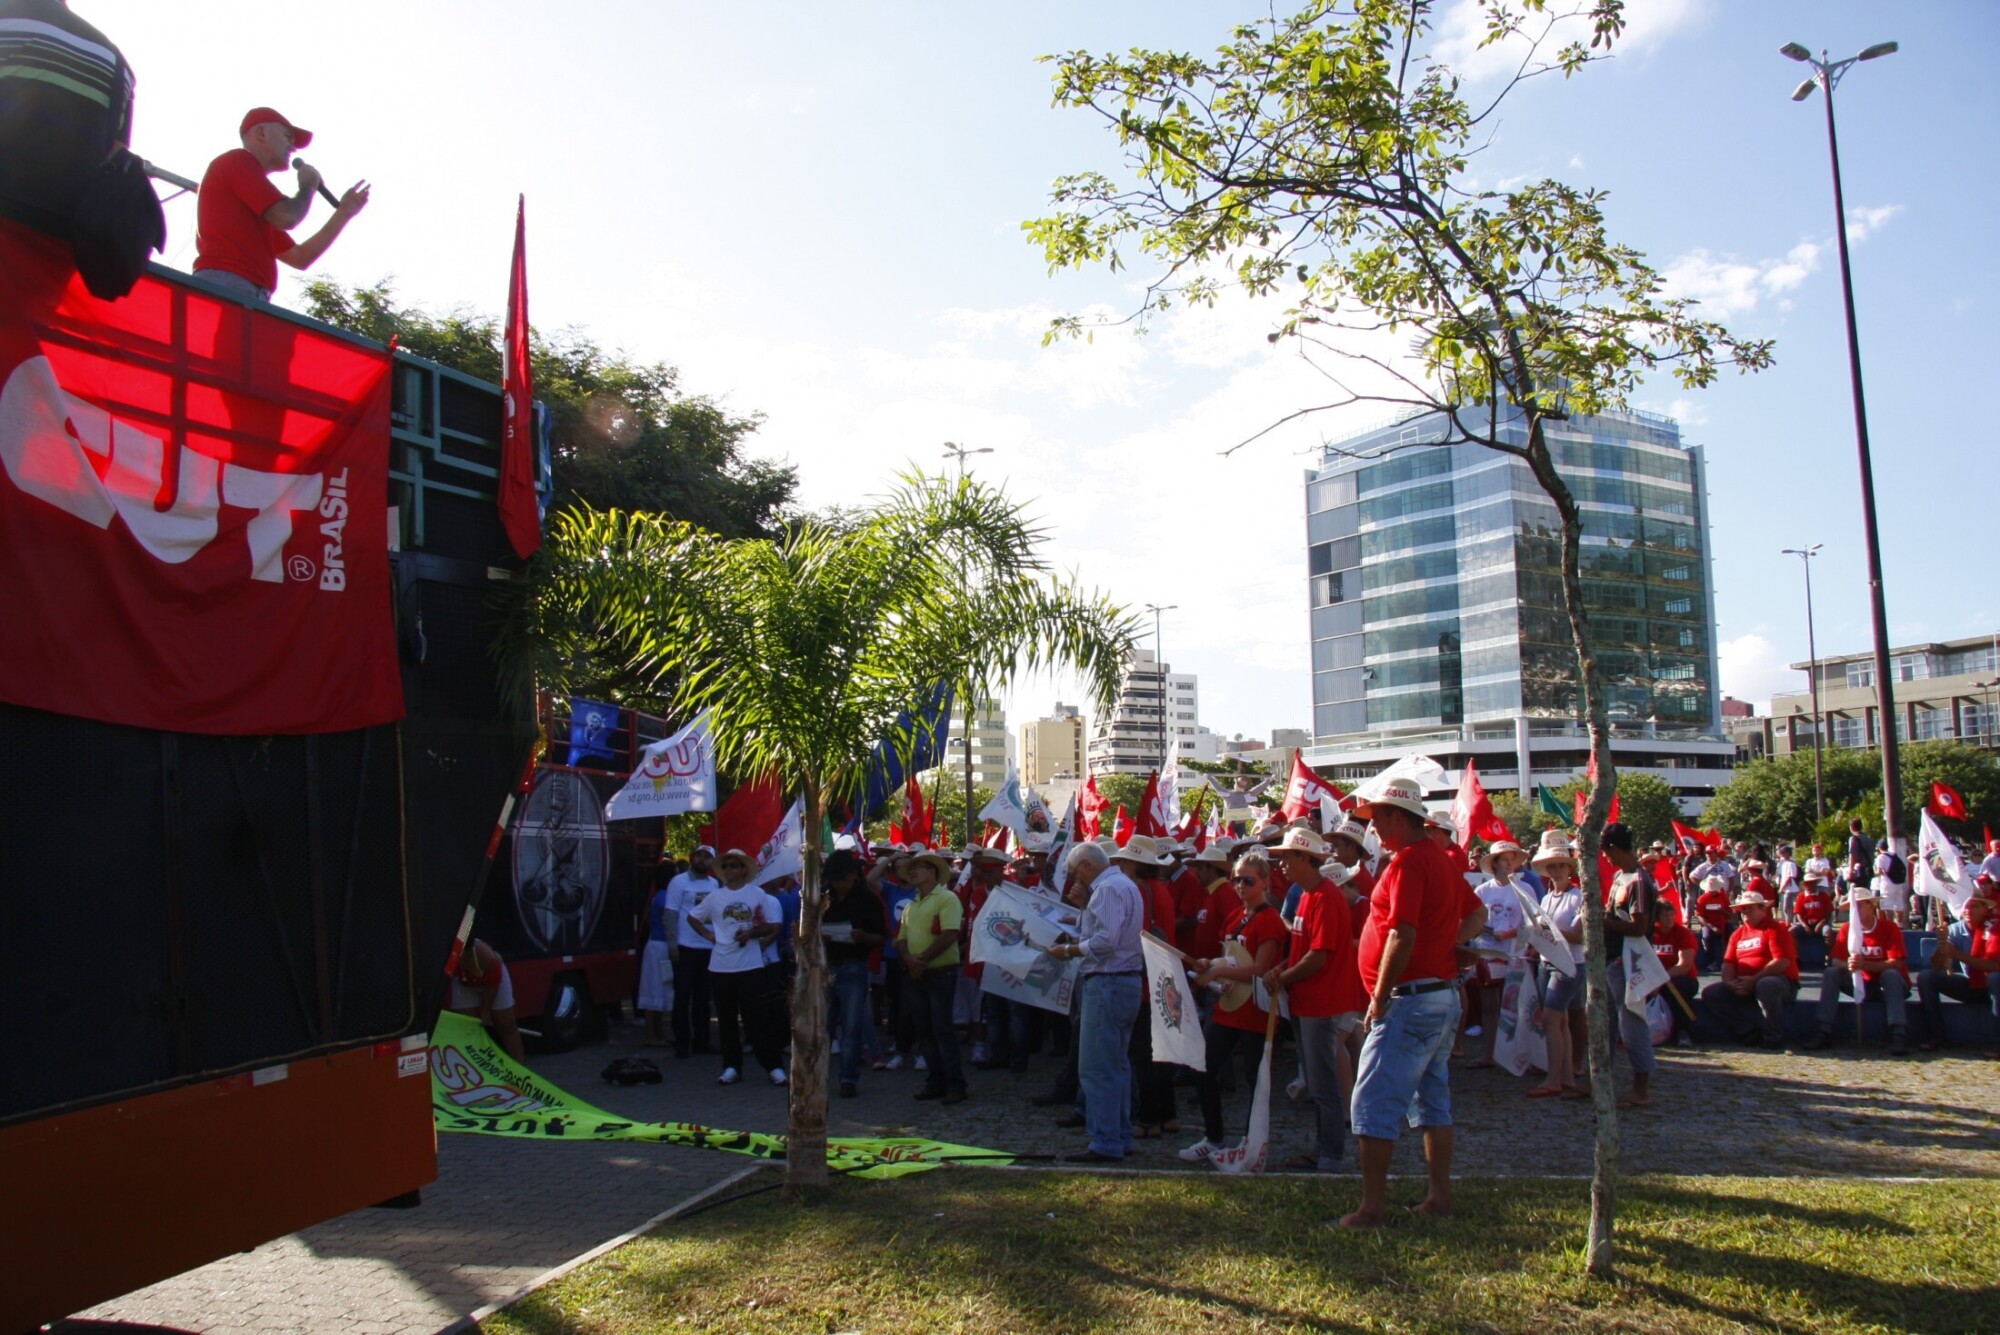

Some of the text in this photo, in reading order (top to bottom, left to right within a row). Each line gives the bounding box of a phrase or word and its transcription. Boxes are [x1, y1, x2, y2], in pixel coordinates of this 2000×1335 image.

[0, 355, 323, 583] CUT
[320, 467, 348, 591] BRASIL
[1861, 945, 1882, 957] UT
